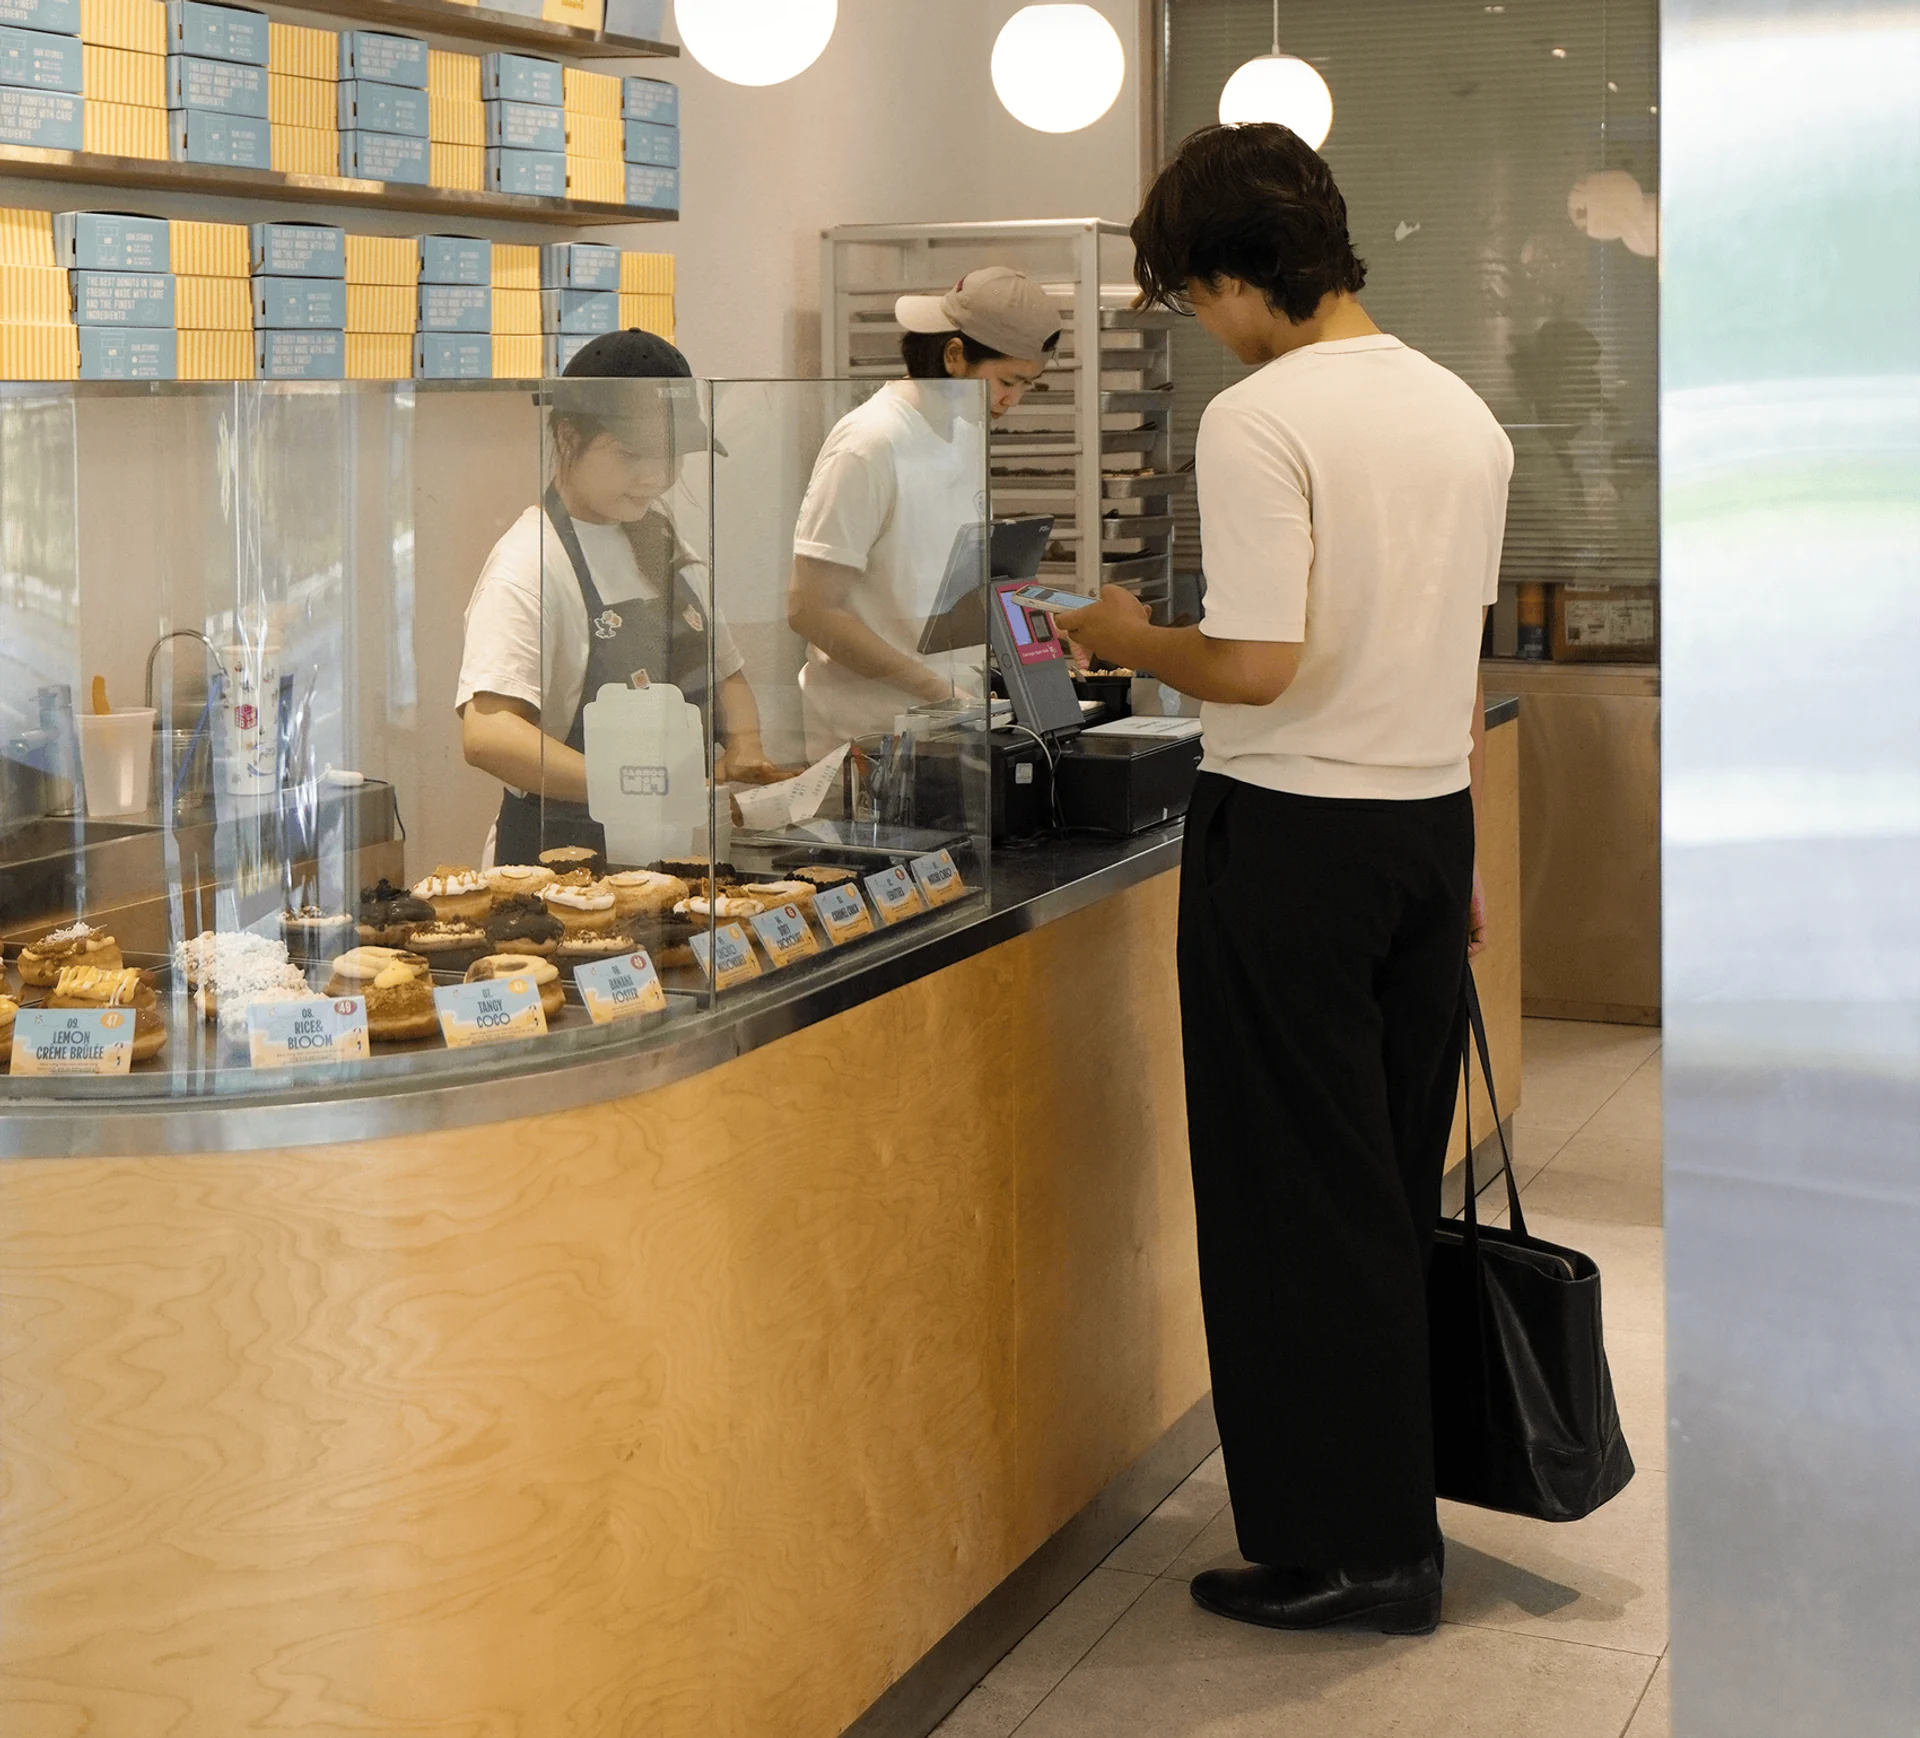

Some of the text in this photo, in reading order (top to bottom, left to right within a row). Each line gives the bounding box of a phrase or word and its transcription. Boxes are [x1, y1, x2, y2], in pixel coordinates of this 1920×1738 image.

[88, 276, 168, 290] THE BEST DONUTS IN TOWN,
[86, 288, 164, 300] FRESHLY MADE WITH CARE
[86, 299, 136, 310] AND THE FINEST
[608, 974, 634, 990] BANANA
[612, 987, 640, 1004] FOSTER
[302, 1008, 314, 1018] 08.
[339, 1001, 352, 1014] 49
[477, 999, 504, 1013] TANGY
[66, 1018, 79, 1028] 09.
[106, 1014, 118, 1027] 47
[476, 1012, 511, 1028] COCO
[52, 1030, 92, 1045] LEMON
[288, 1034, 334, 1050] BLOOM
